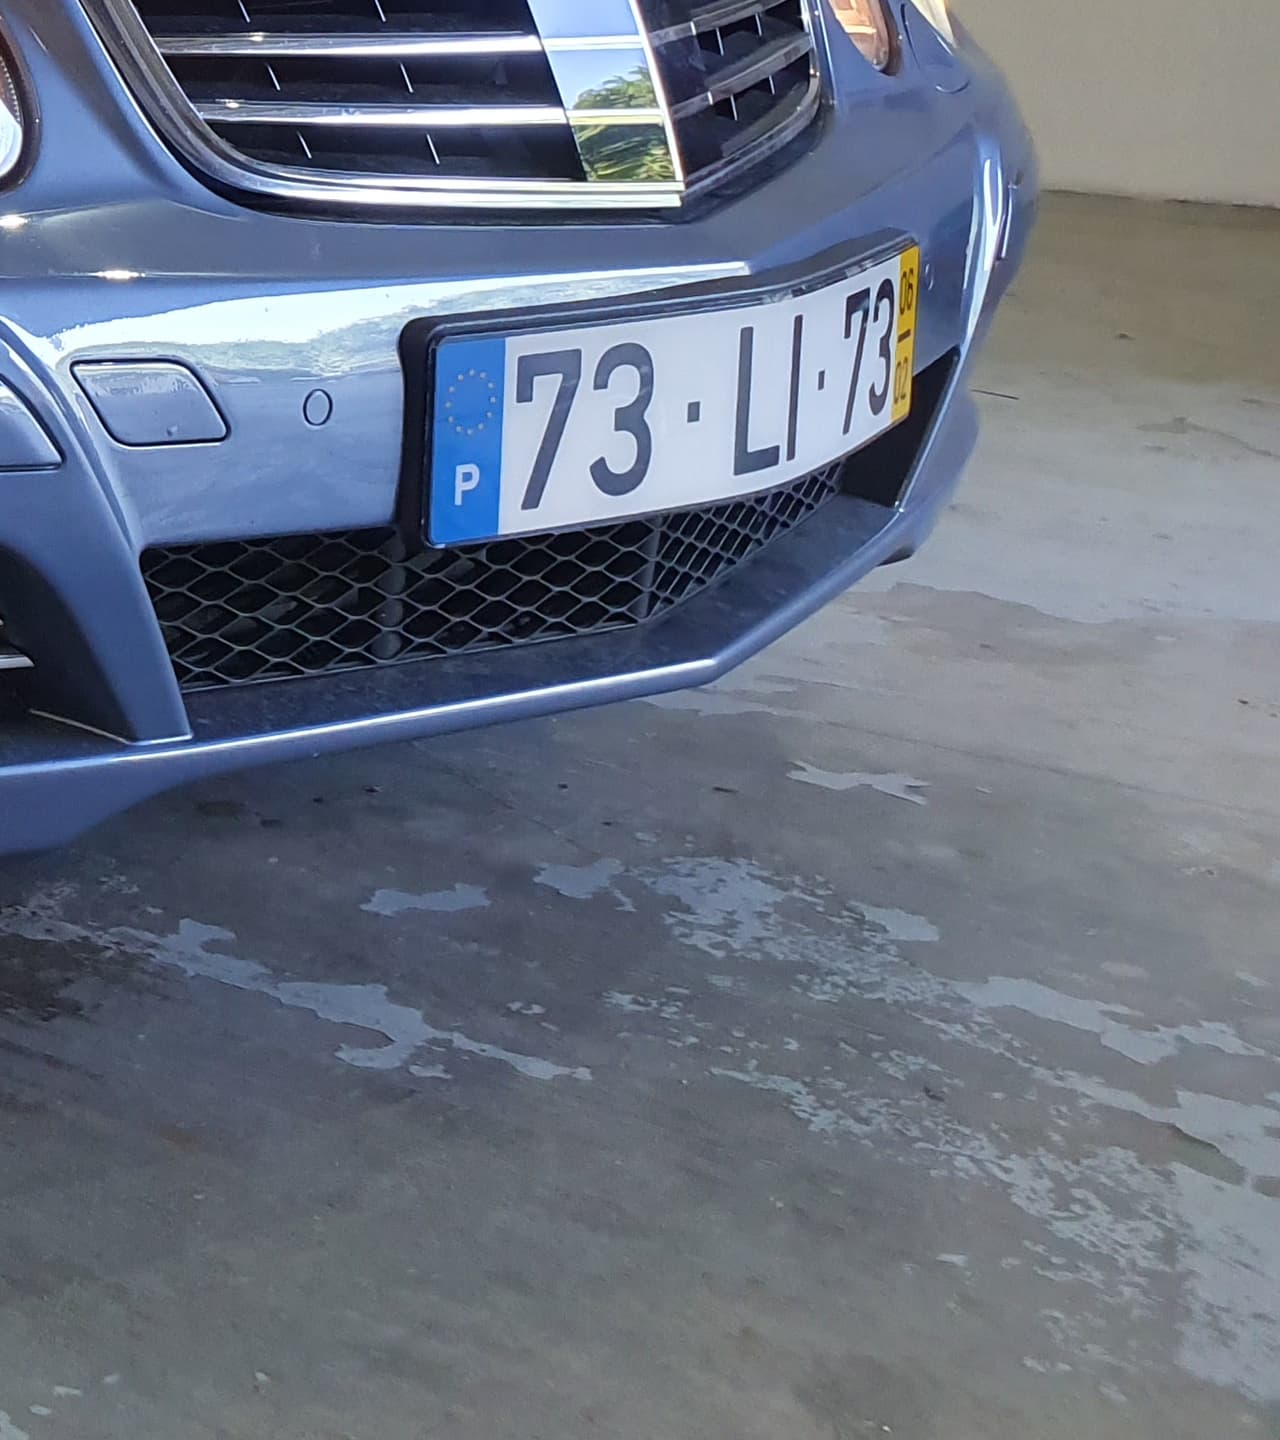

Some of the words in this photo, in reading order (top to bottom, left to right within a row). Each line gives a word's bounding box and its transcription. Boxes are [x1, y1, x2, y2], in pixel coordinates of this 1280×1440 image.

[899, 268, 914, 315] 06
[894, 357, 908, 405] 02
[454, 464, 480, 505] P
